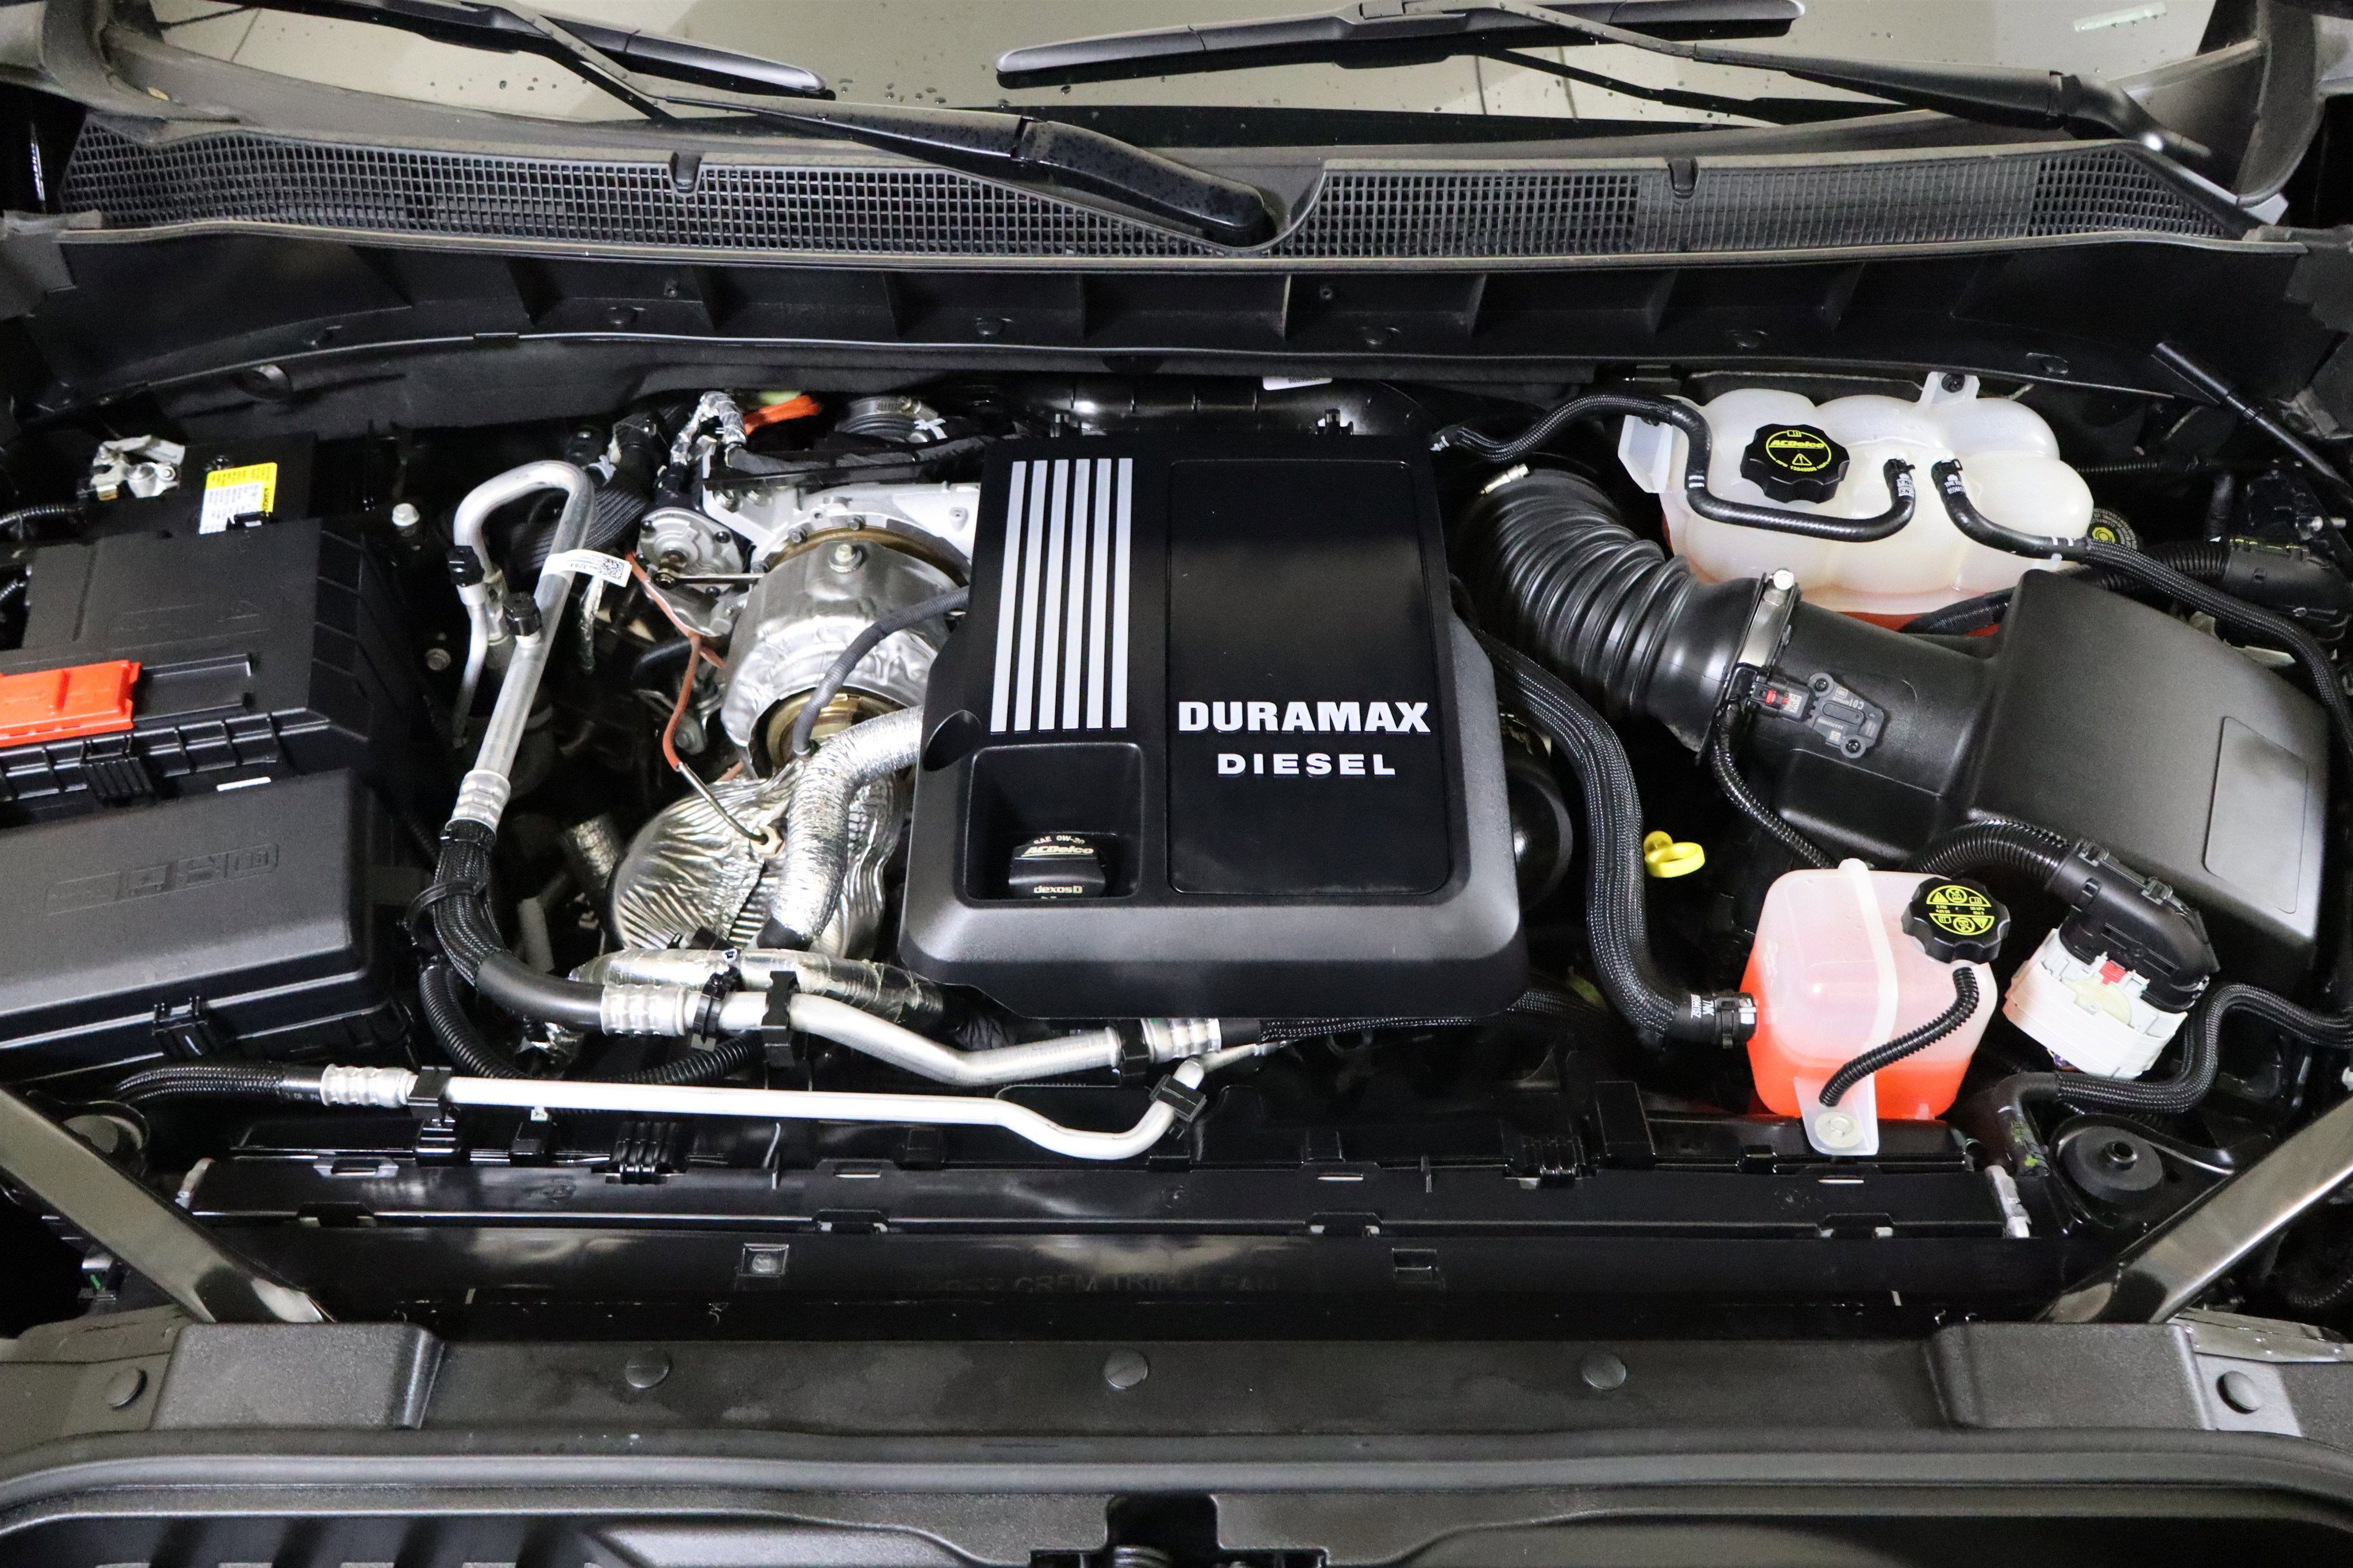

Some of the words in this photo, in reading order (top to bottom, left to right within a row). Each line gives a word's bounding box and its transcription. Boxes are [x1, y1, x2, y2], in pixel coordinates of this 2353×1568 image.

[1770, 439, 1825, 448] ACDelco
[1178, 701, 1430, 733] DURAMAX
[1217, 752, 1396, 777] DIESEL
[1033, 836, 1052, 844] SAE
[1021, 845, 1094, 856] ACDelco
